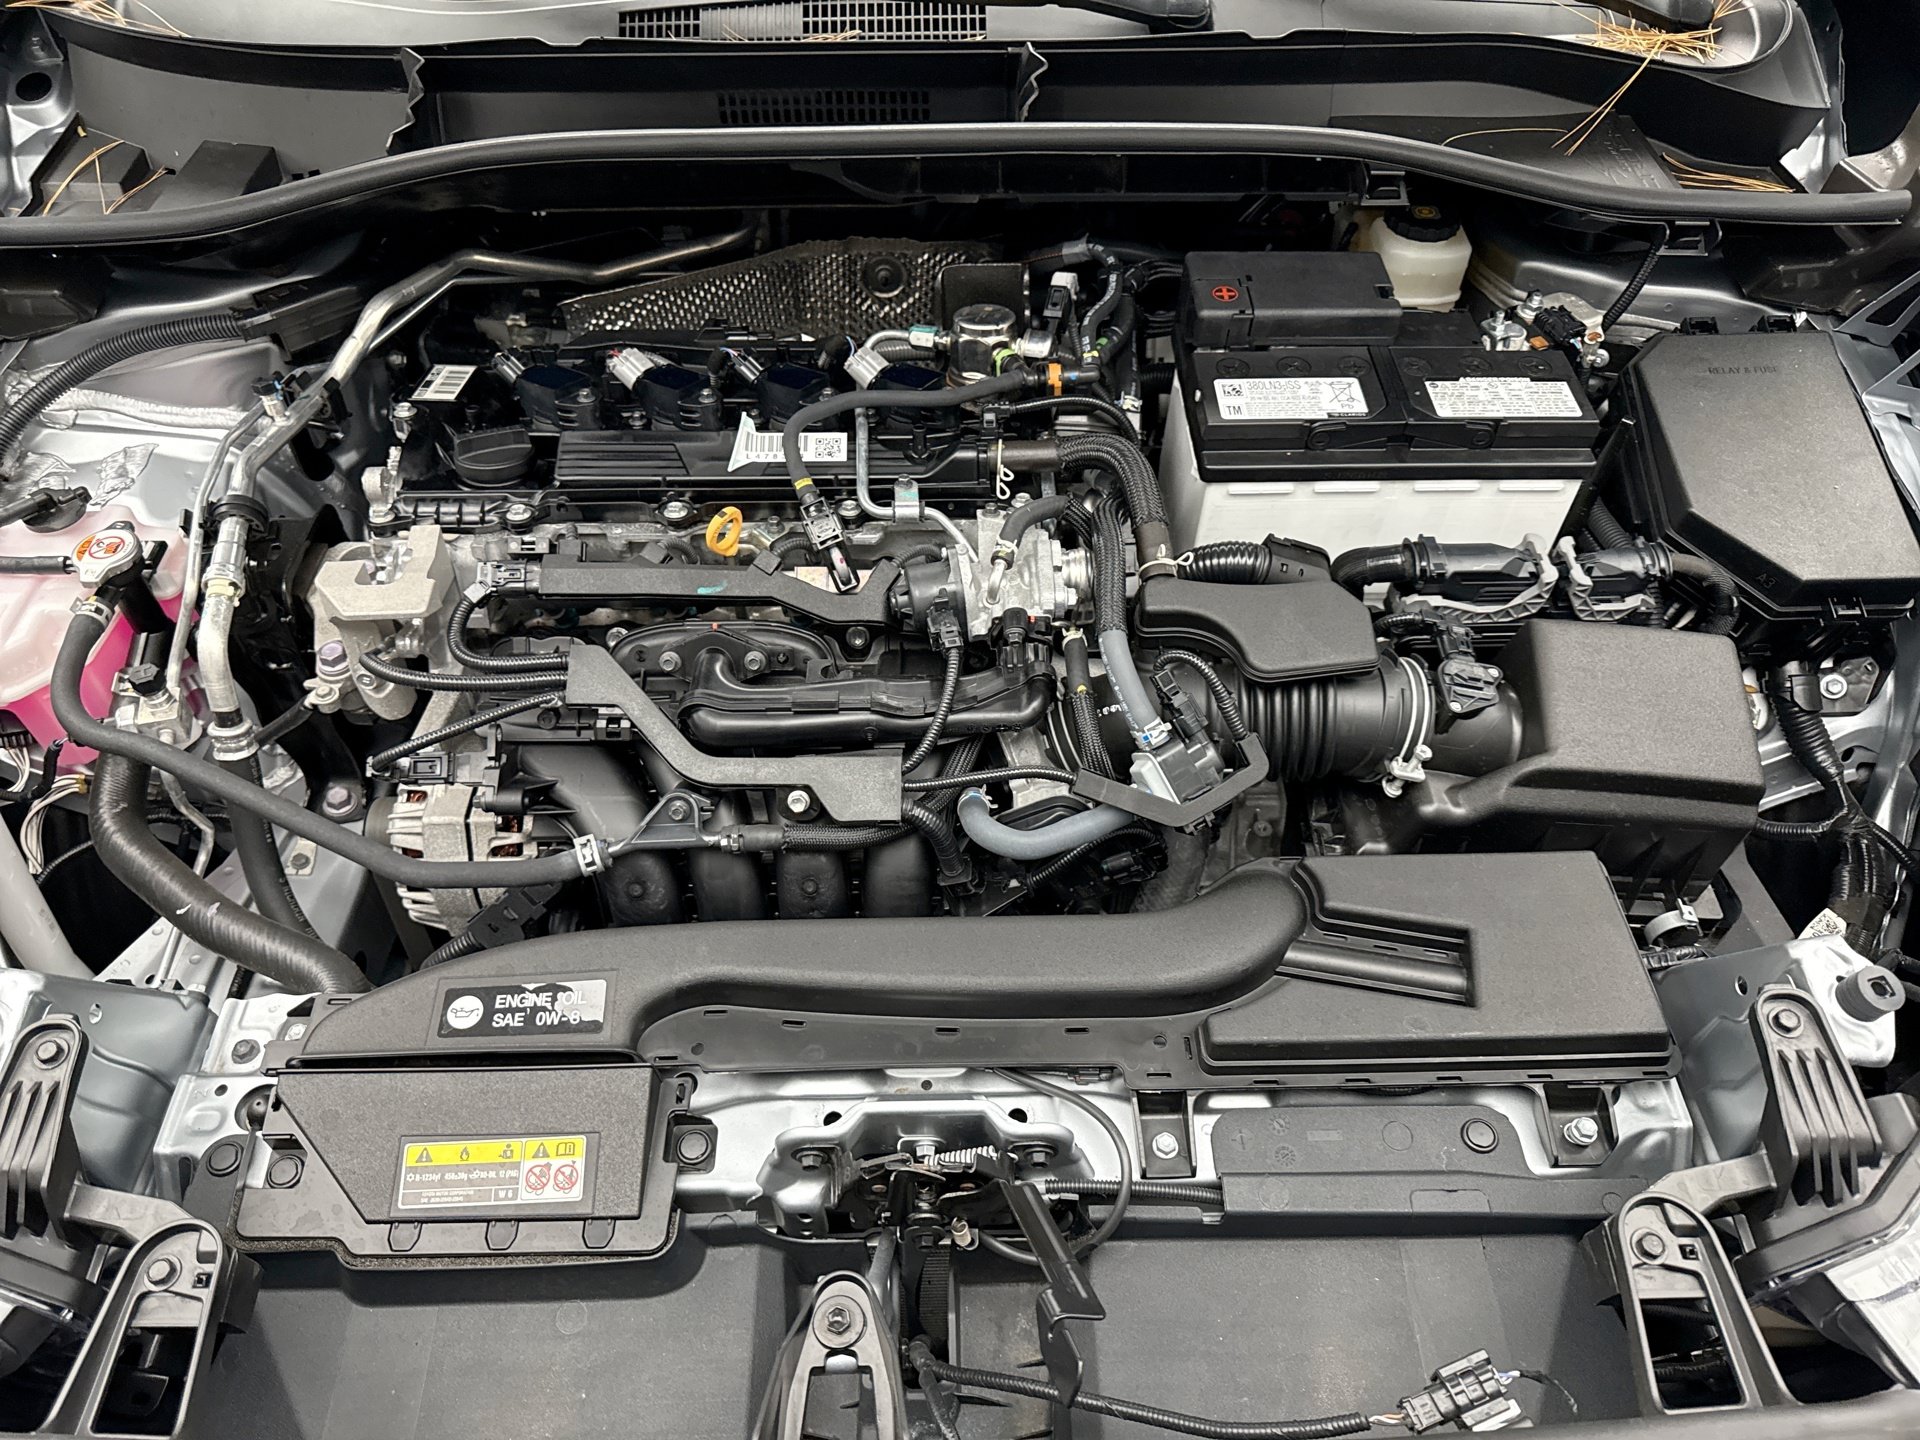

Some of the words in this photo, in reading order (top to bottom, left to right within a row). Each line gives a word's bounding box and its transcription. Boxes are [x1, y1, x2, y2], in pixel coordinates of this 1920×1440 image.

[1707, 366, 1741, 375] RELAY
[1743, 366, 1752, 374] &
[1246, 380, 1301, 391] 380LN3-ISS
[1226, 405, 1243, 416] TM
[494, 992, 553, 1009] ENGINE
[562, 990, 587, 1005] OIL
[491, 1012, 526, 1028] SAE
[535, 1010, 581, 1026] 0W-8
[499, 1189, 508, 1199] W
